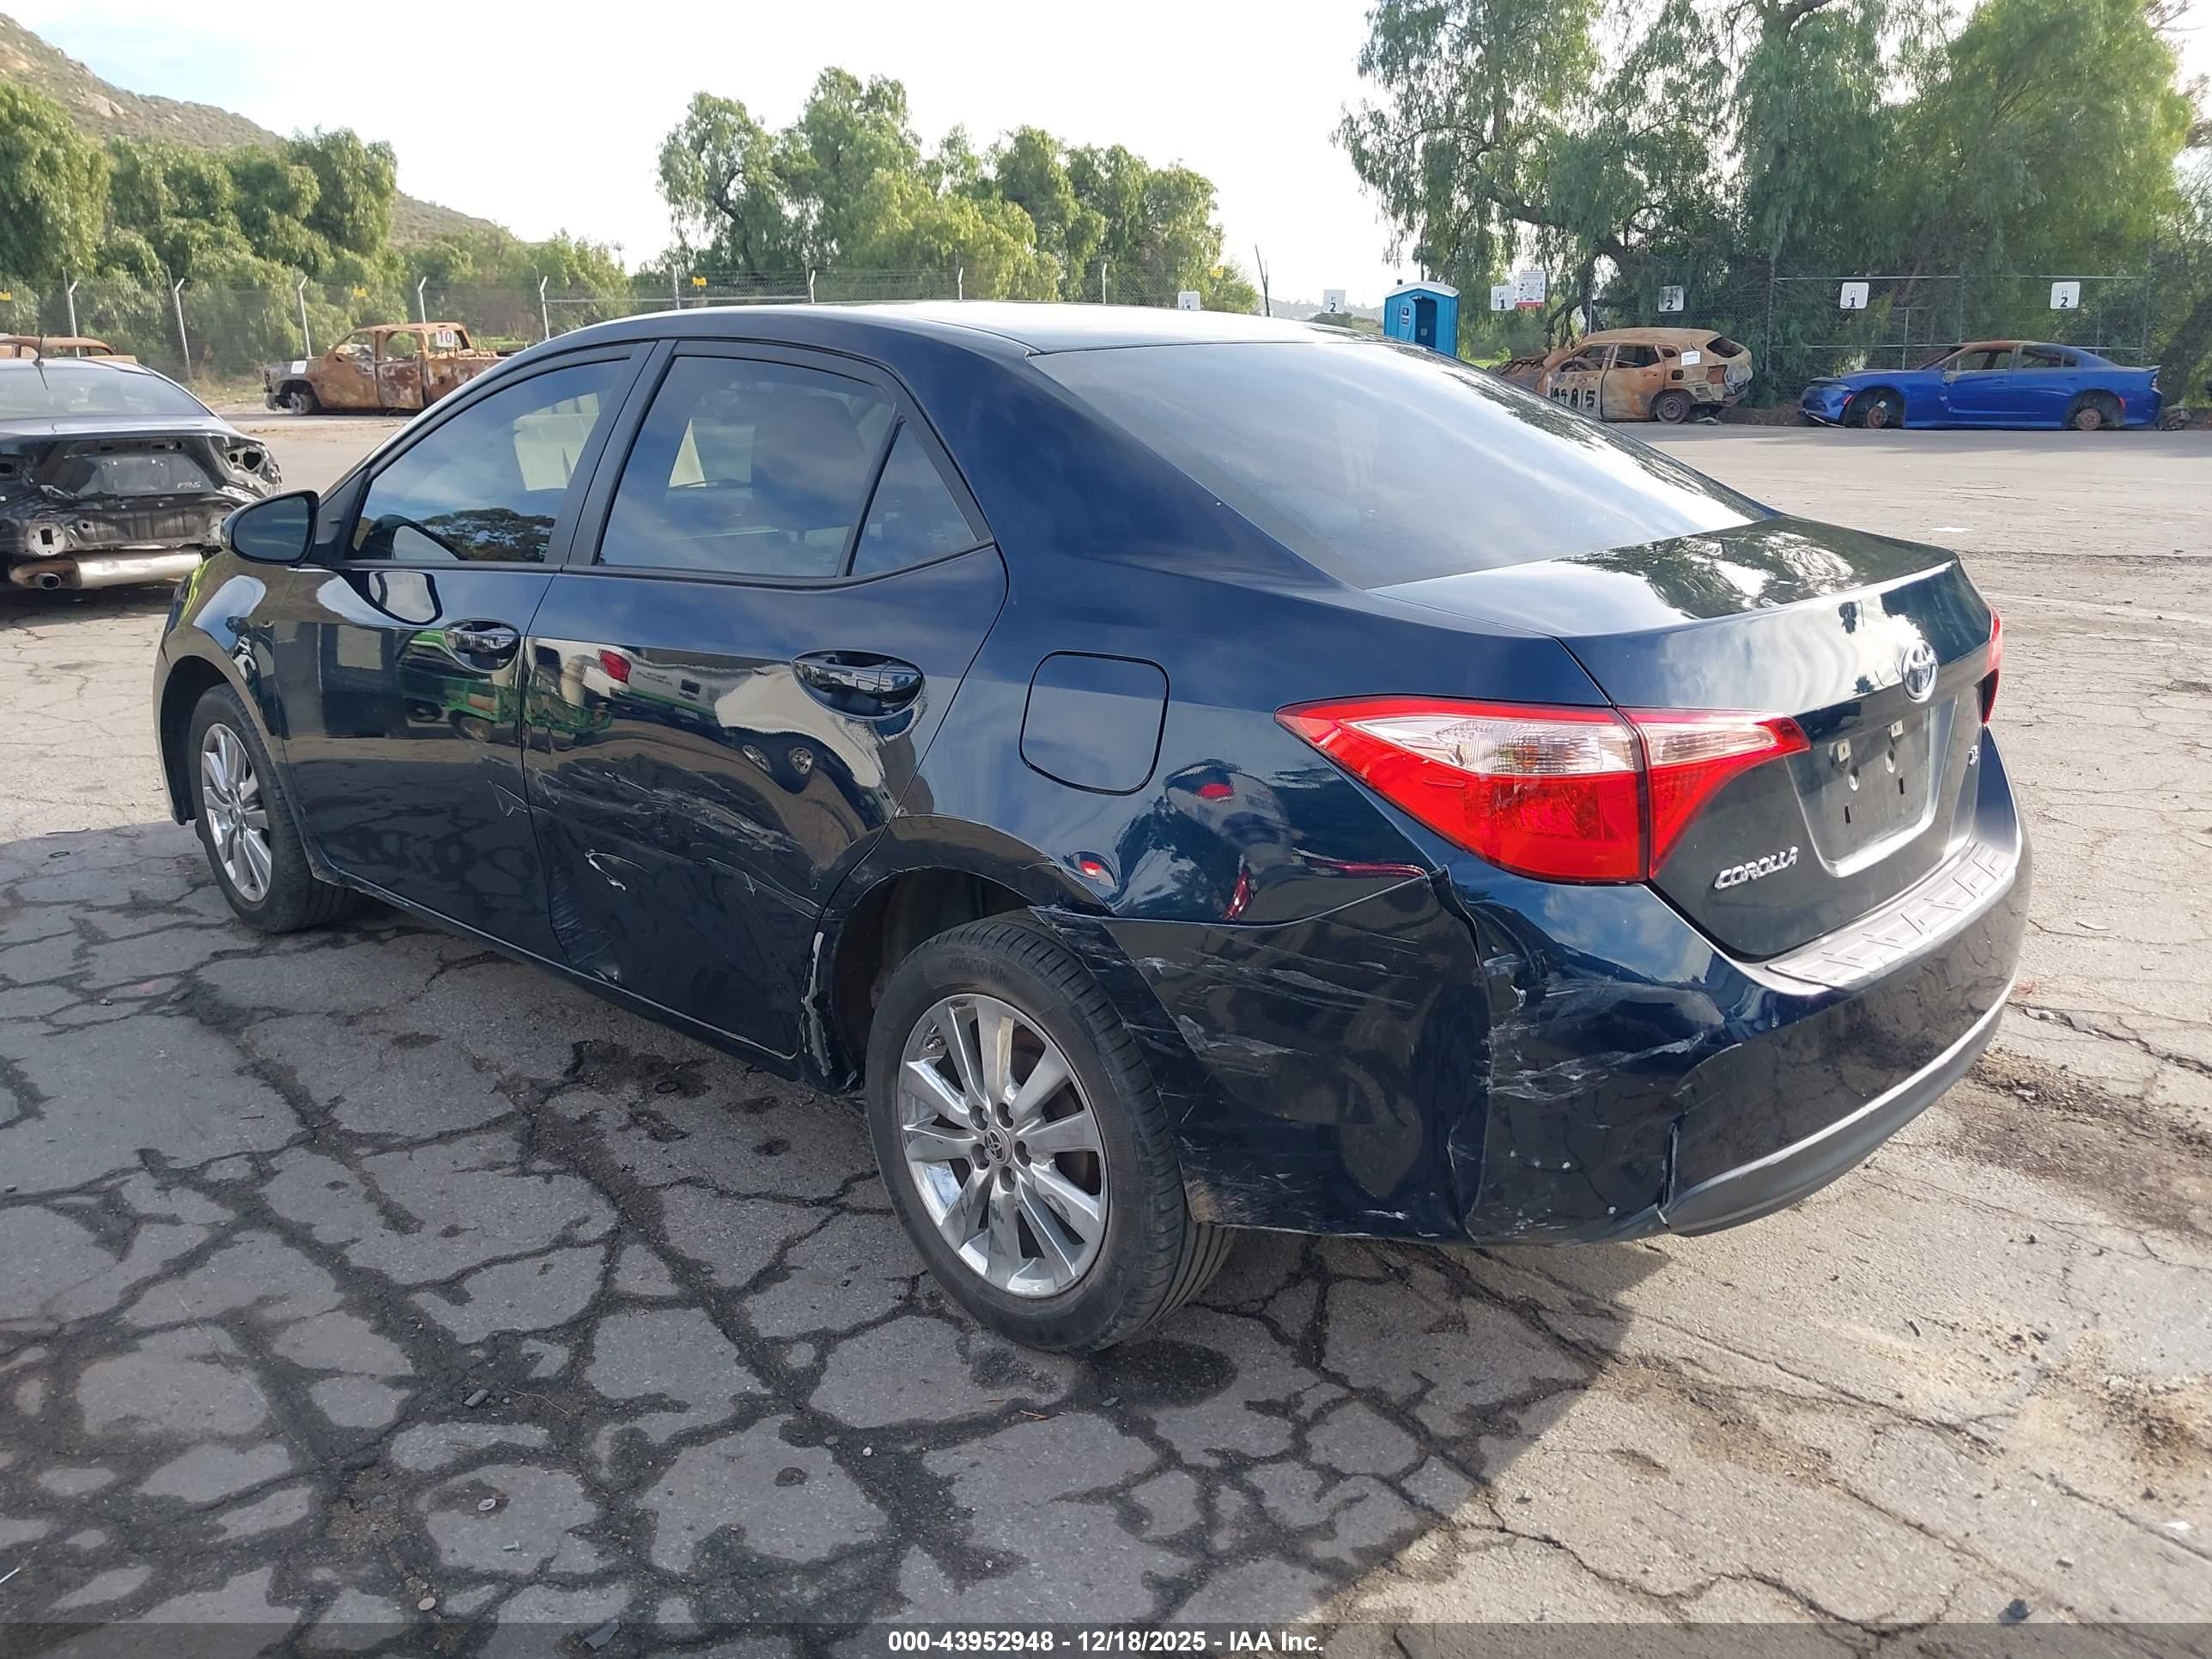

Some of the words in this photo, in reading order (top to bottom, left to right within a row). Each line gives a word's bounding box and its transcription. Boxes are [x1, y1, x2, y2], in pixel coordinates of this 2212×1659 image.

[1499, 299, 1506, 309] 1
[1666, 300, 1674, 310] 2
[1850, 296, 1856, 307] 1
[2060, 296, 2069, 308] 2
[1329, 302, 1336, 313] 2
[439, 331, 453, 343] 10
[1714, 846, 1799, 890] COROLLA
